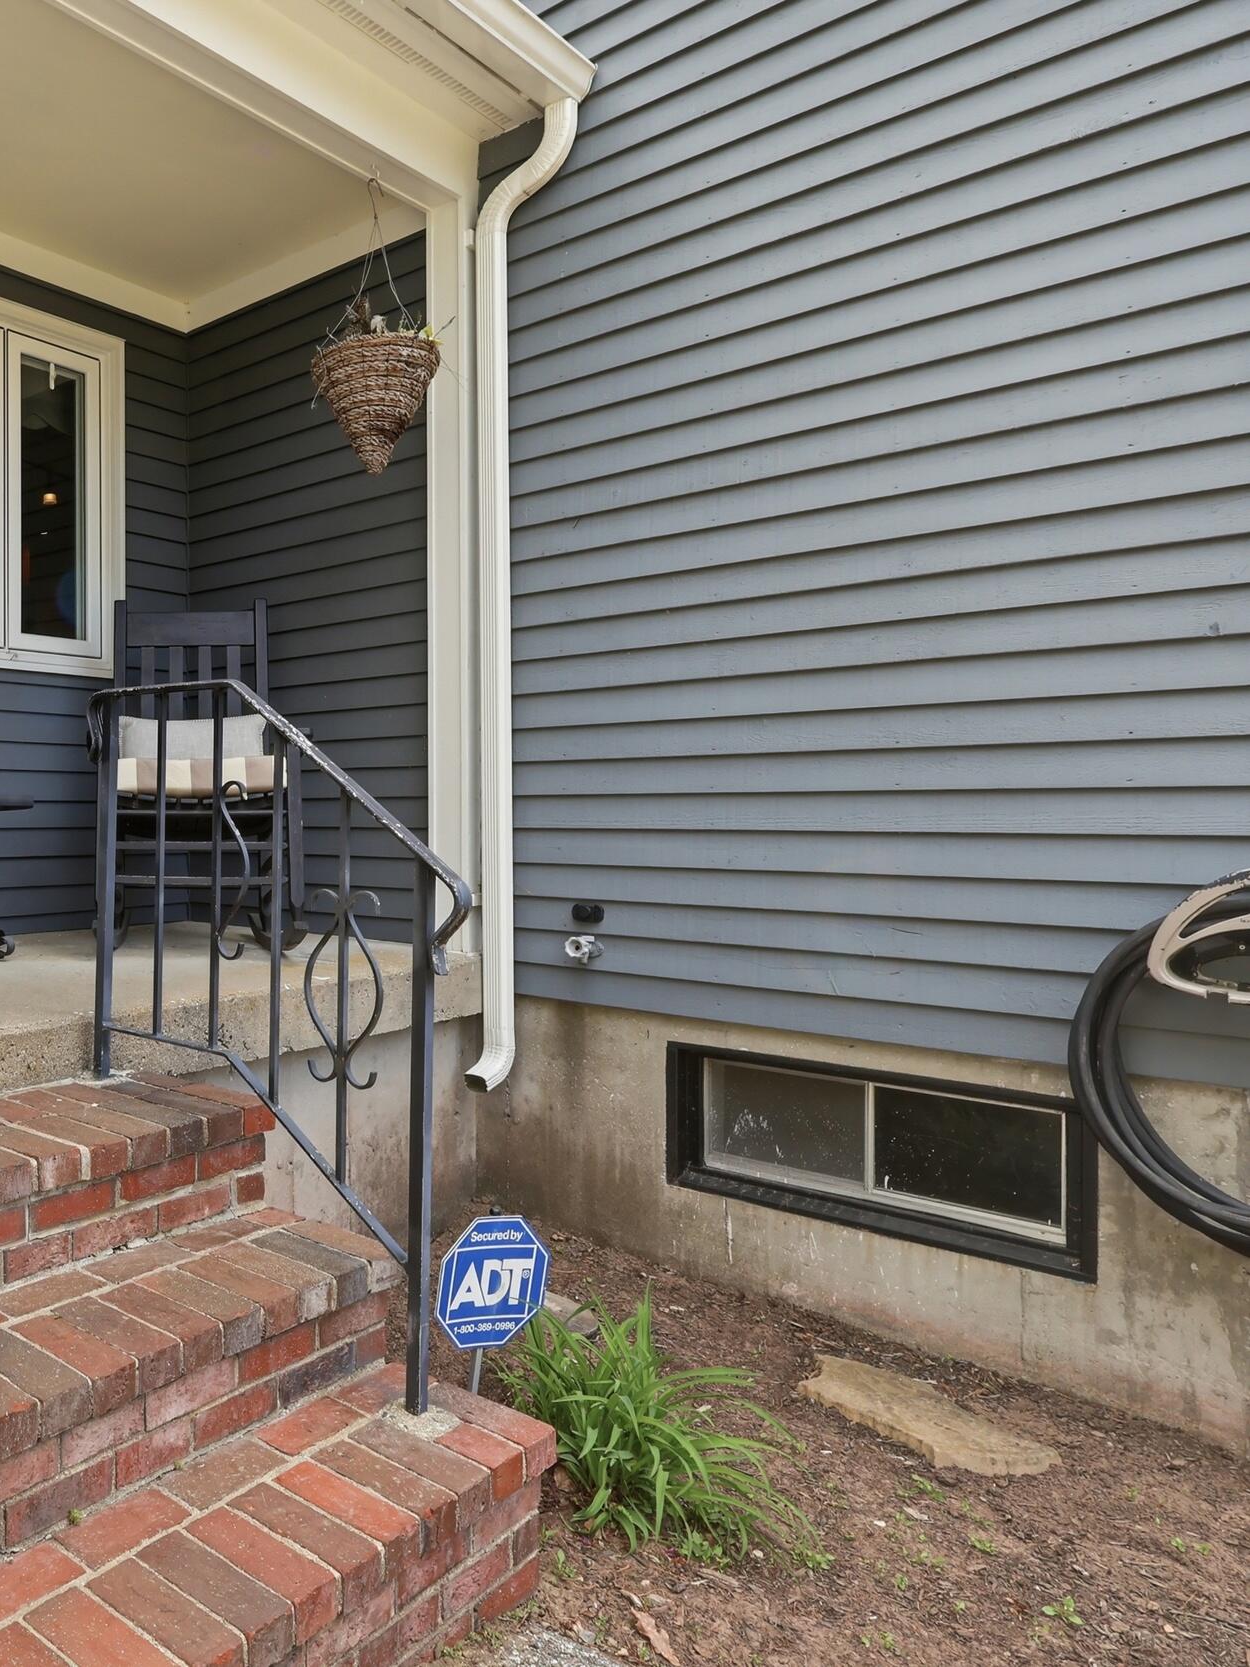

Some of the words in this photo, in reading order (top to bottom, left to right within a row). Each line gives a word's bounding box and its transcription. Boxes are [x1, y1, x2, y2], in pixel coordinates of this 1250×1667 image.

[470, 1229, 510, 1243] Secured
[510, 1229, 524, 1242] by
[450, 1258, 533, 1310] ADT
